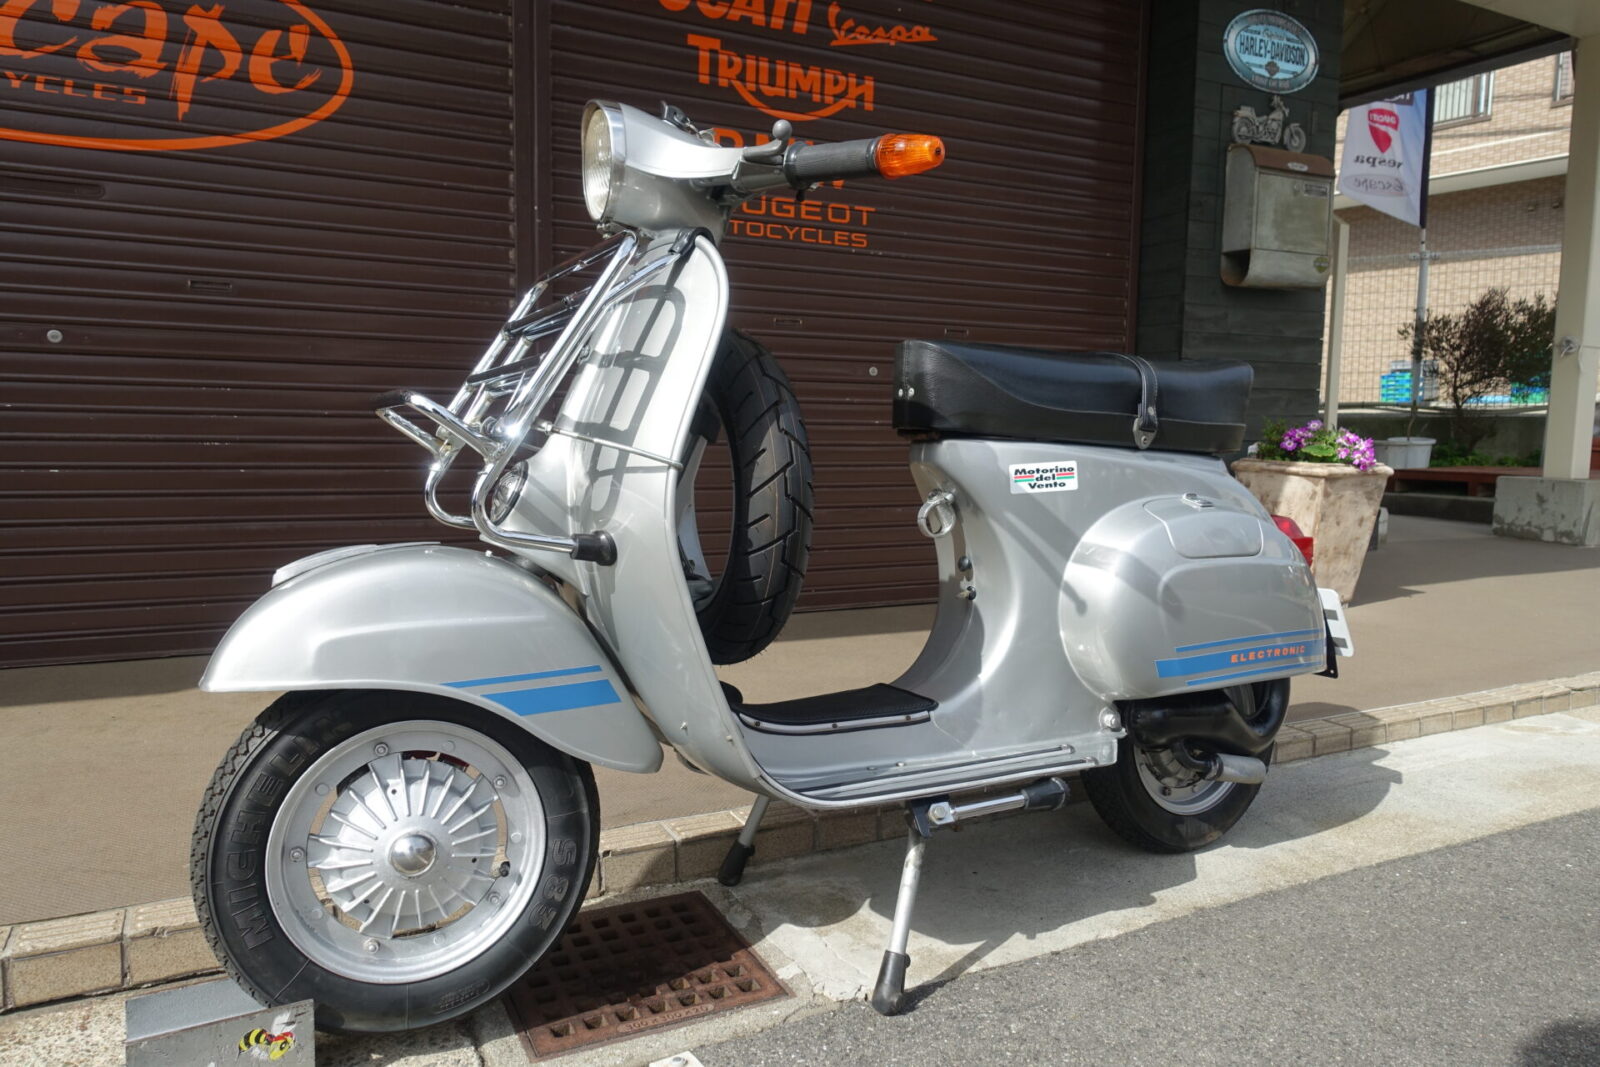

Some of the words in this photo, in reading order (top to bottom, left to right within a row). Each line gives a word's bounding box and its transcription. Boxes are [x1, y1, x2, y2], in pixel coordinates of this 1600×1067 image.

[828, 1, 938, 46] Vespa
[1239, 33, 1306, 67] HARLEY-DAVIDSON
[687, 33, 875, 112] TRIUMPH
[733, 195, 876, 226] UGEOT
[1014, 466, 1075, 476] Motorino
[1035, 469, 1056, 481] del
[1028, 481, 1066, 489] Vento
[1230, 645, 1305, 664] ELECTRONIC
